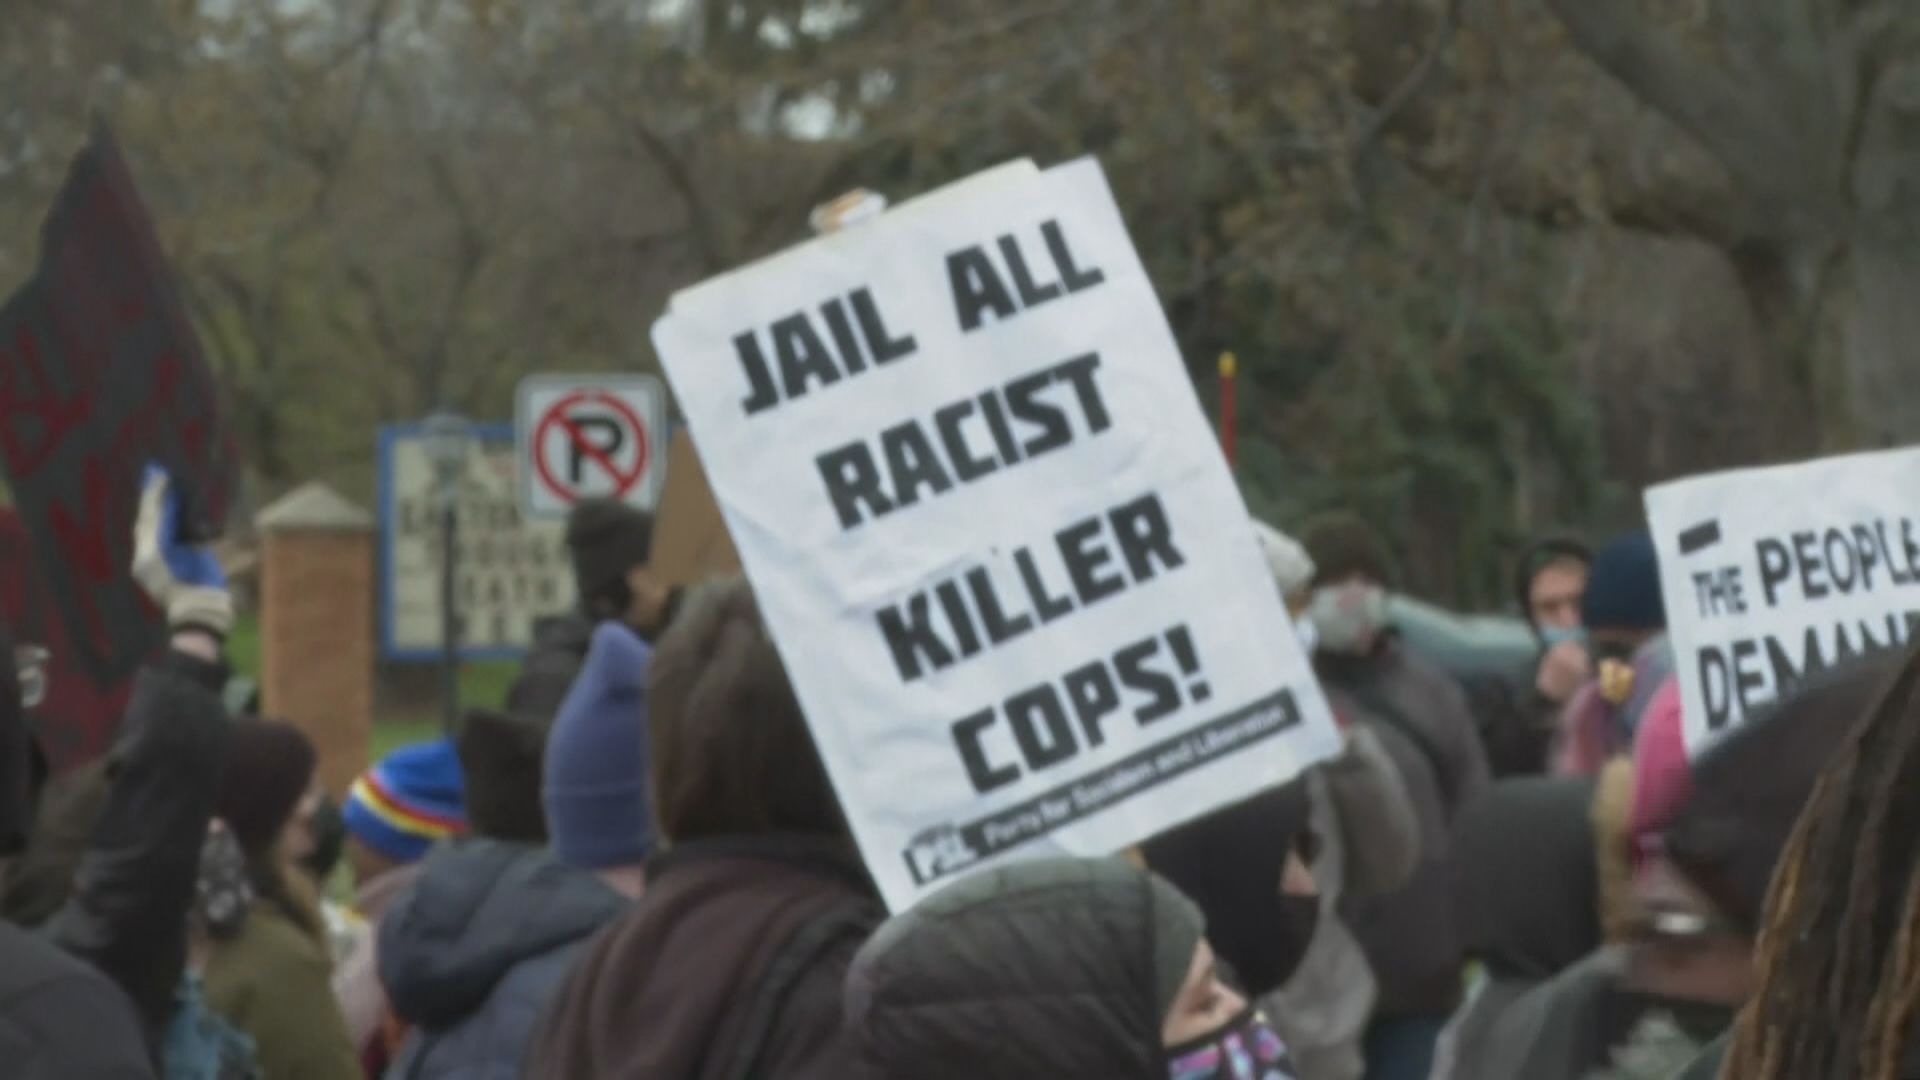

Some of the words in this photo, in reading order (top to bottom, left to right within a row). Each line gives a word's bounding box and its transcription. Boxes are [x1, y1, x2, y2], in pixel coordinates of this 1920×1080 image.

[732, 287, 917, 416] JAIL
[945, 219, 1105, 333] ALL
[815, 352, 1111, 530] RACIST
[875, 491, 1185, 682] KILLER
[1692, 565, 1748, 618] THE
[1755, 519, 1920, 606] PEOPLE
[951, 624, 1212, 795] COPS!
[1697, 612, 1920, 732] DEMA
